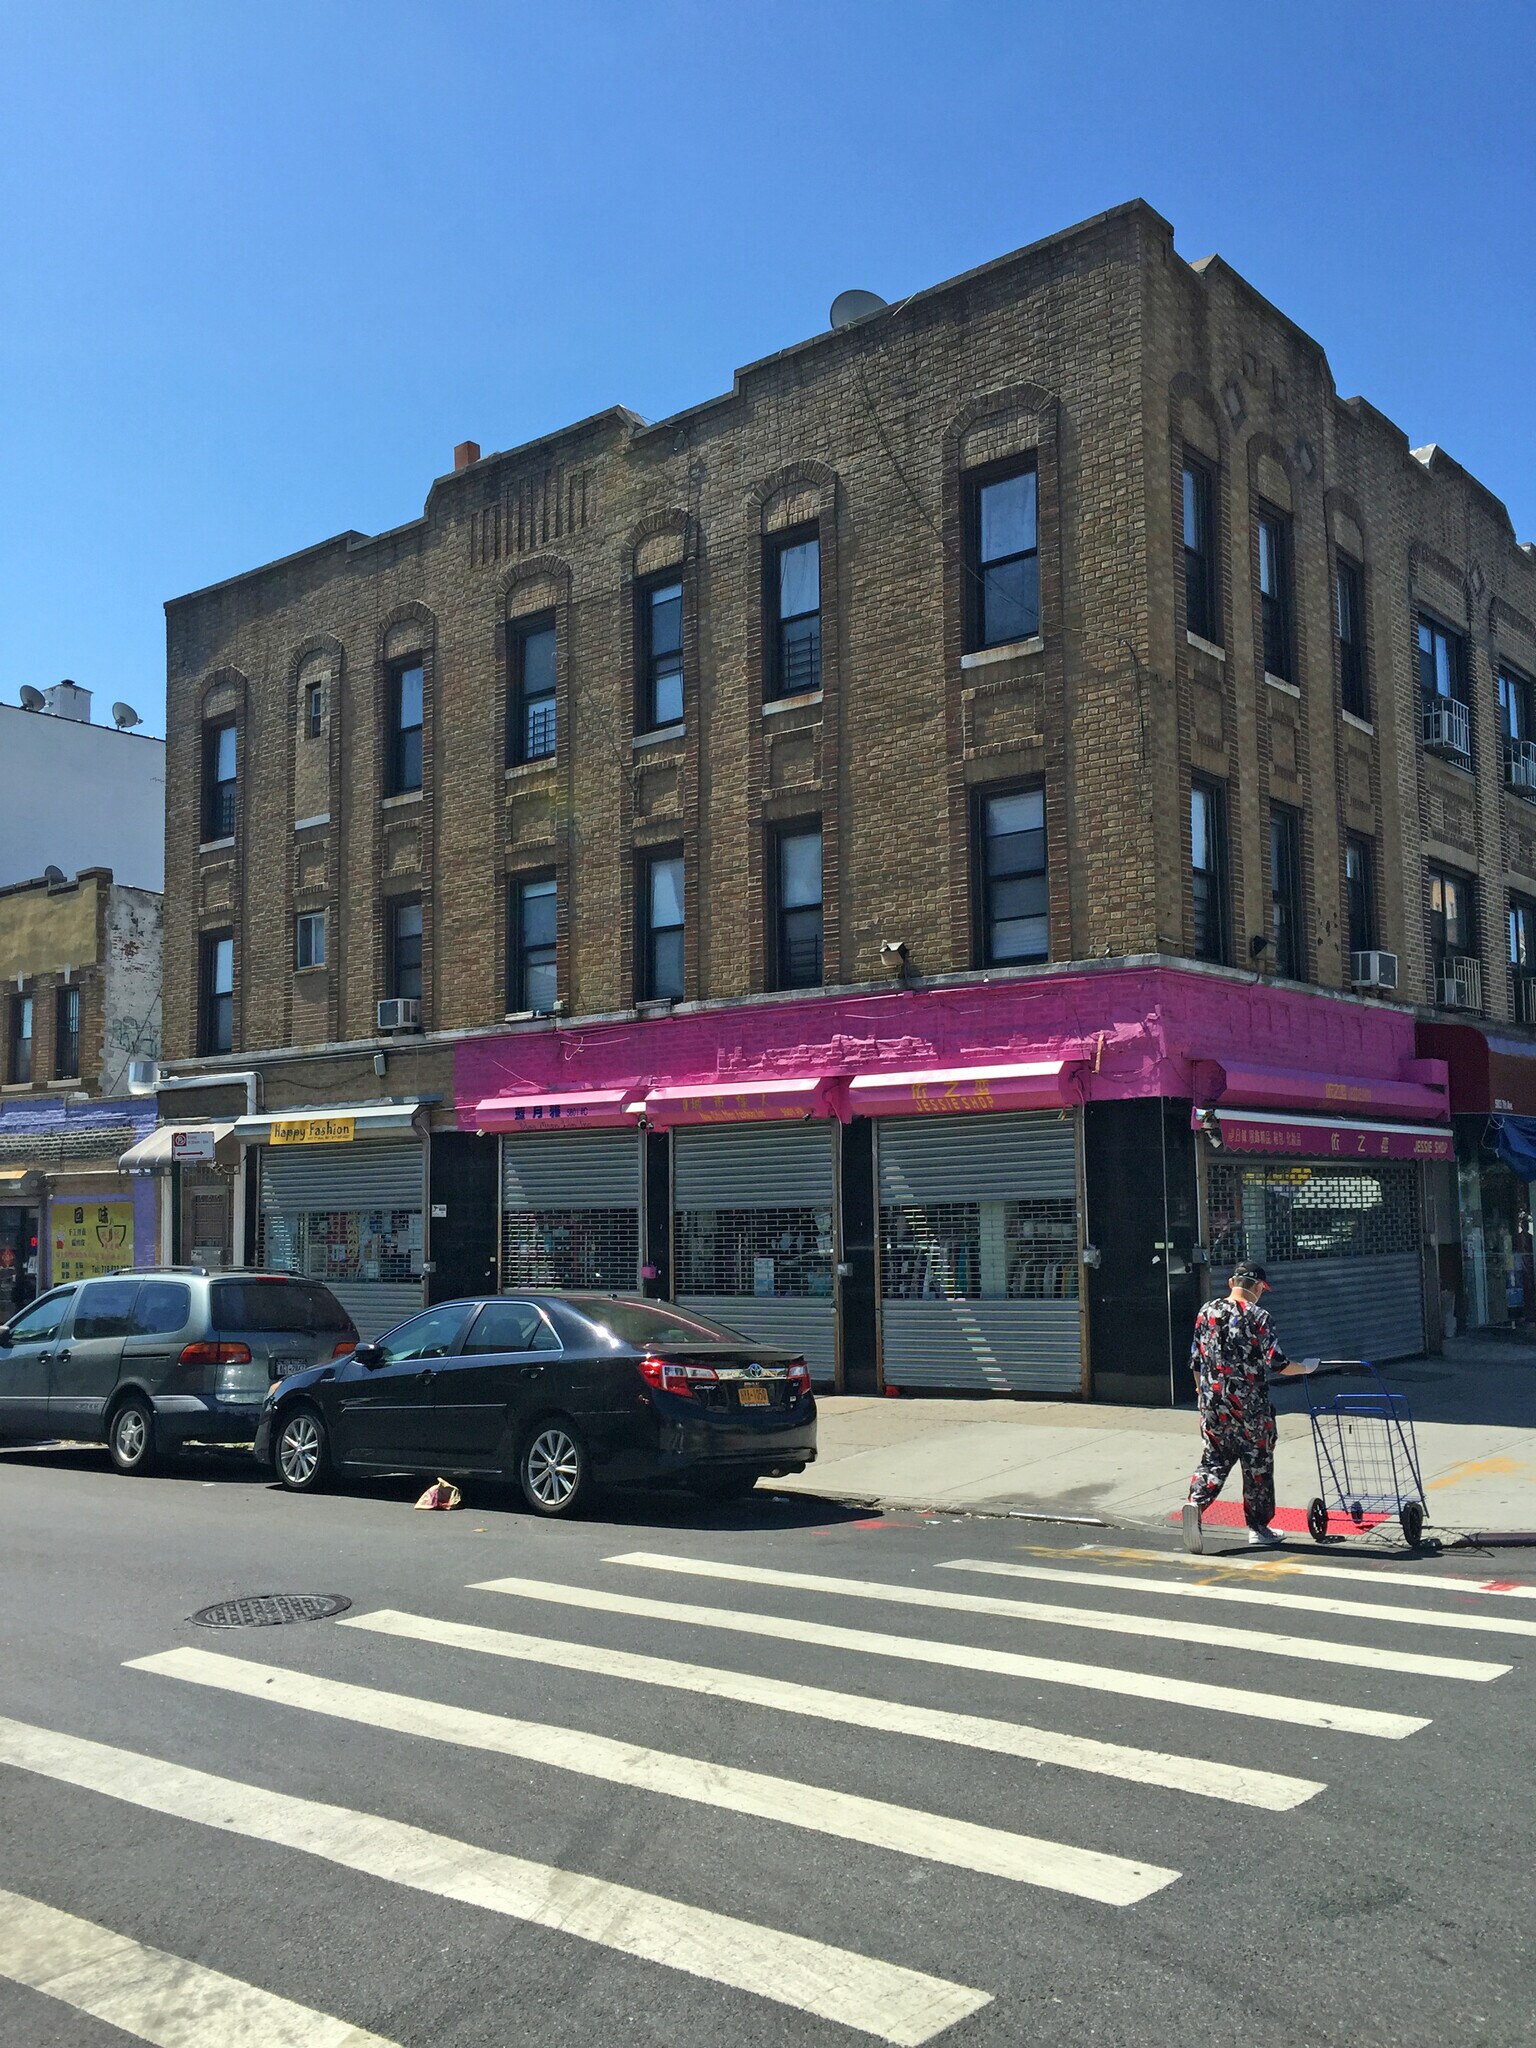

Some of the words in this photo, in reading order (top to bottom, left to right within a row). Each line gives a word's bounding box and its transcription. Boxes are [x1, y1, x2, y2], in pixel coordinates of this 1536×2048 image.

[915, 1097, 961, 1112] JESSIE
[961, 1096, 994, 1110] SHOP
[274, 1123, 306, 1141] Happy
[309, 1120, 350, 1137] Fashion
[1413, 1140, 1433, 1153] JESSIE
[1435, 1141, 1448, 1154] SHOP
